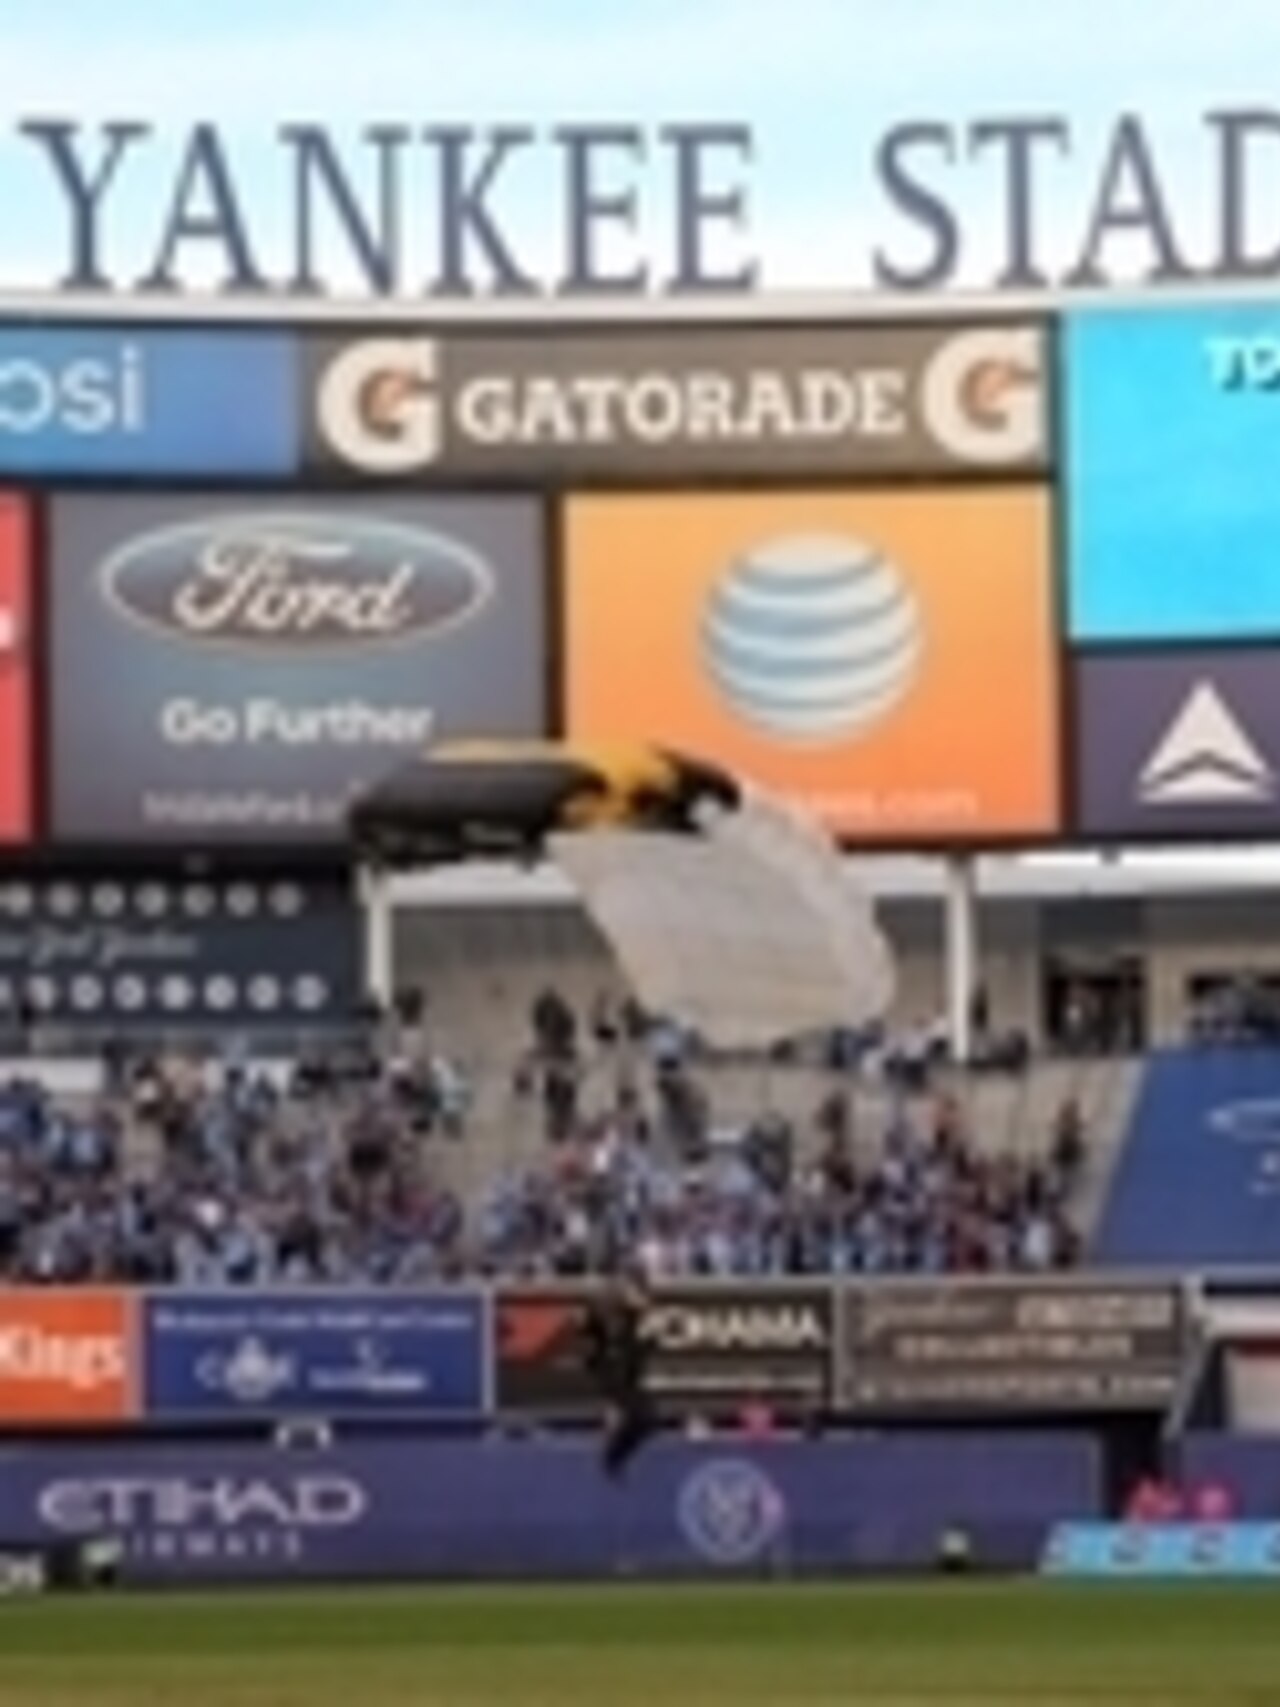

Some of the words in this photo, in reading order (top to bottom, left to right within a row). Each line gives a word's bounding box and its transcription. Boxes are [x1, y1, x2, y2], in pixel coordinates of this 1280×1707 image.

[17, 118, 761, 300] YANKEE
[456, 368, 907, 444] GATORADE
[172, 535, 417, 632] Ford
[161, 698, 238, 744] Go
[245, 697, 433, 744] Further
[37, 1477, 366, 1532] ETIHAD
